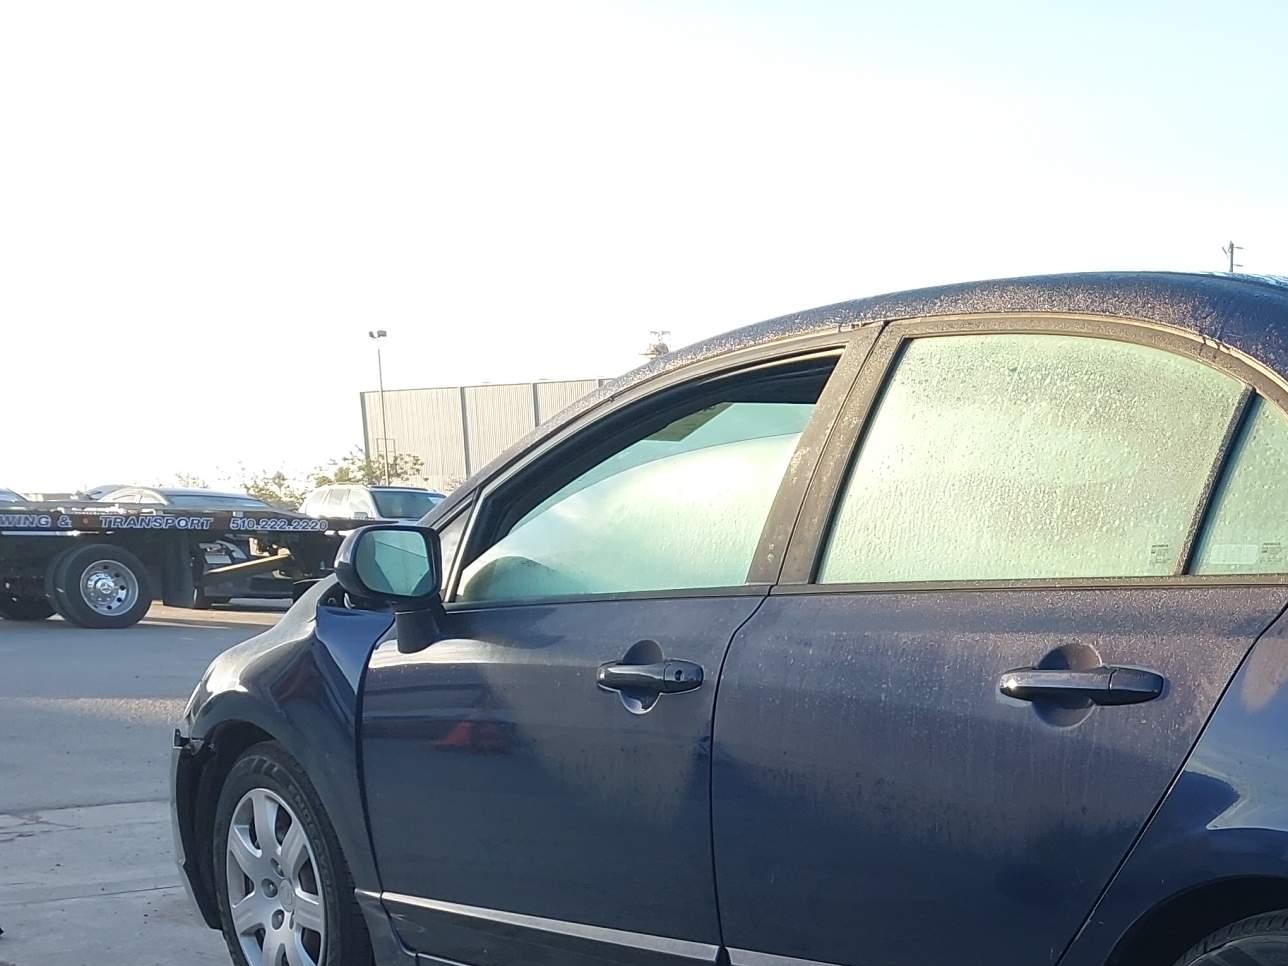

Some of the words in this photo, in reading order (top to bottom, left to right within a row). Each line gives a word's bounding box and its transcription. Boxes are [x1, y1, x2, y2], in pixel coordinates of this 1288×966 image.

[57, 514, 72, 528] &
[100, 515, 213, 530] TRANSPORT
[229, 518, 328, 531] 510.222.2220
